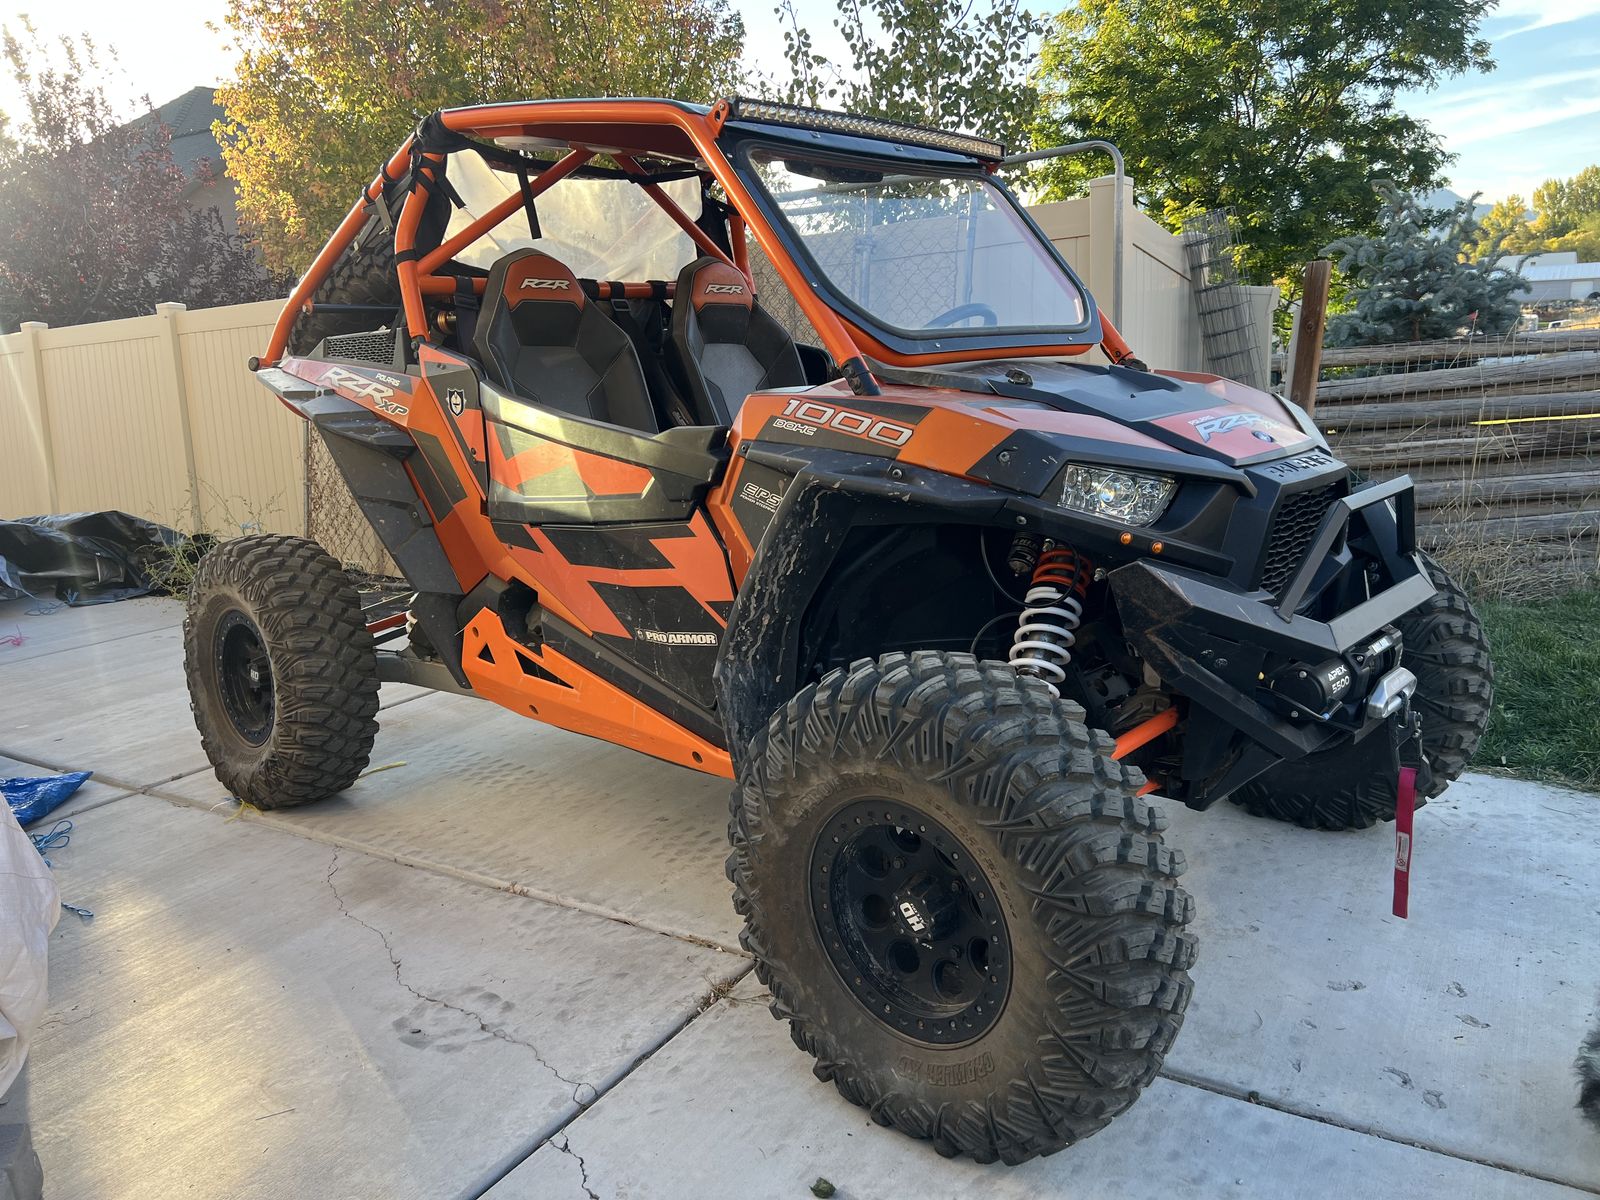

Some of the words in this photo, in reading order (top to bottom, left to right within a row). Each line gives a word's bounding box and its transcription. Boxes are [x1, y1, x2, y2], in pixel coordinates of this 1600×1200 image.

[520, 278, 570, 290] RZR
[705, 284, 744, 295] RZR
[316, 367, 395, 405] RZR
[375, 373, 400, 387] POLARIS
[376, 399, 409, 416] XP
[773, 418, 817, 436] DOHC
[782, 399, 914, 447] 1000
[743, 482, 783, 506] EPS
[645, 631, 667, 643] PRO
[668, 634, 716, 644] ARMOR
[1327, 664, 1347, 682] APEX
[1332, 675, 1350, 694] 5500
[900, 902, 925, 932] HD
